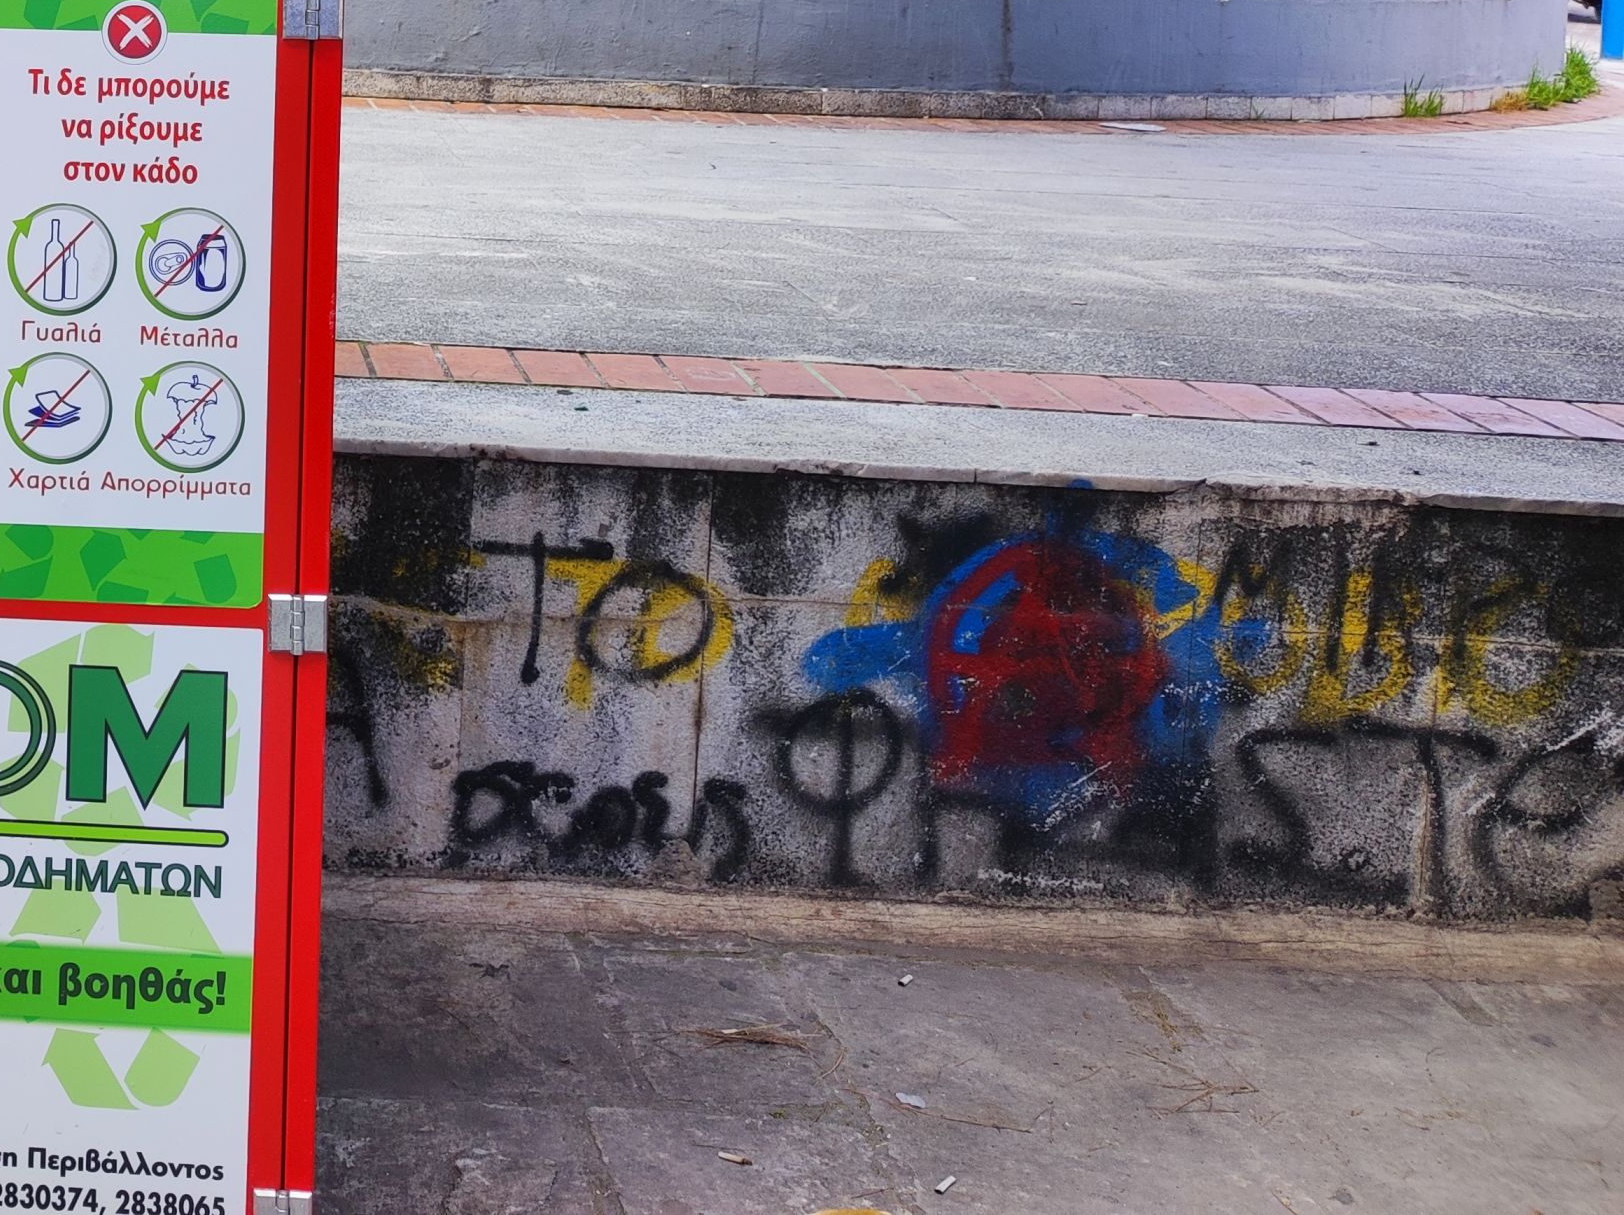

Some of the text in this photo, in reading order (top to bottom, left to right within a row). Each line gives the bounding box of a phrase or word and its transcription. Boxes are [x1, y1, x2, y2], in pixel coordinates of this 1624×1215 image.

[27, 67, 231, 106] Τι δε μπορούμε
[61, 113, 203, 148] να ρίξουμε
[63, 156, 199, 185] στον κάδο
[20, 320, 102, 343] Γυαλιά
[139, 325, 239, 349] Μέταλλα
[8, 467, 91, 497] Χαρτιά
[100, 471, 252, 500] Απορρίμματα
[57, 961, 227, 1014] βοηθάς!
[27, 1147, 225, 1181] Περιβάλλοντος
[114, 1189, 226, 1215] 2838065
